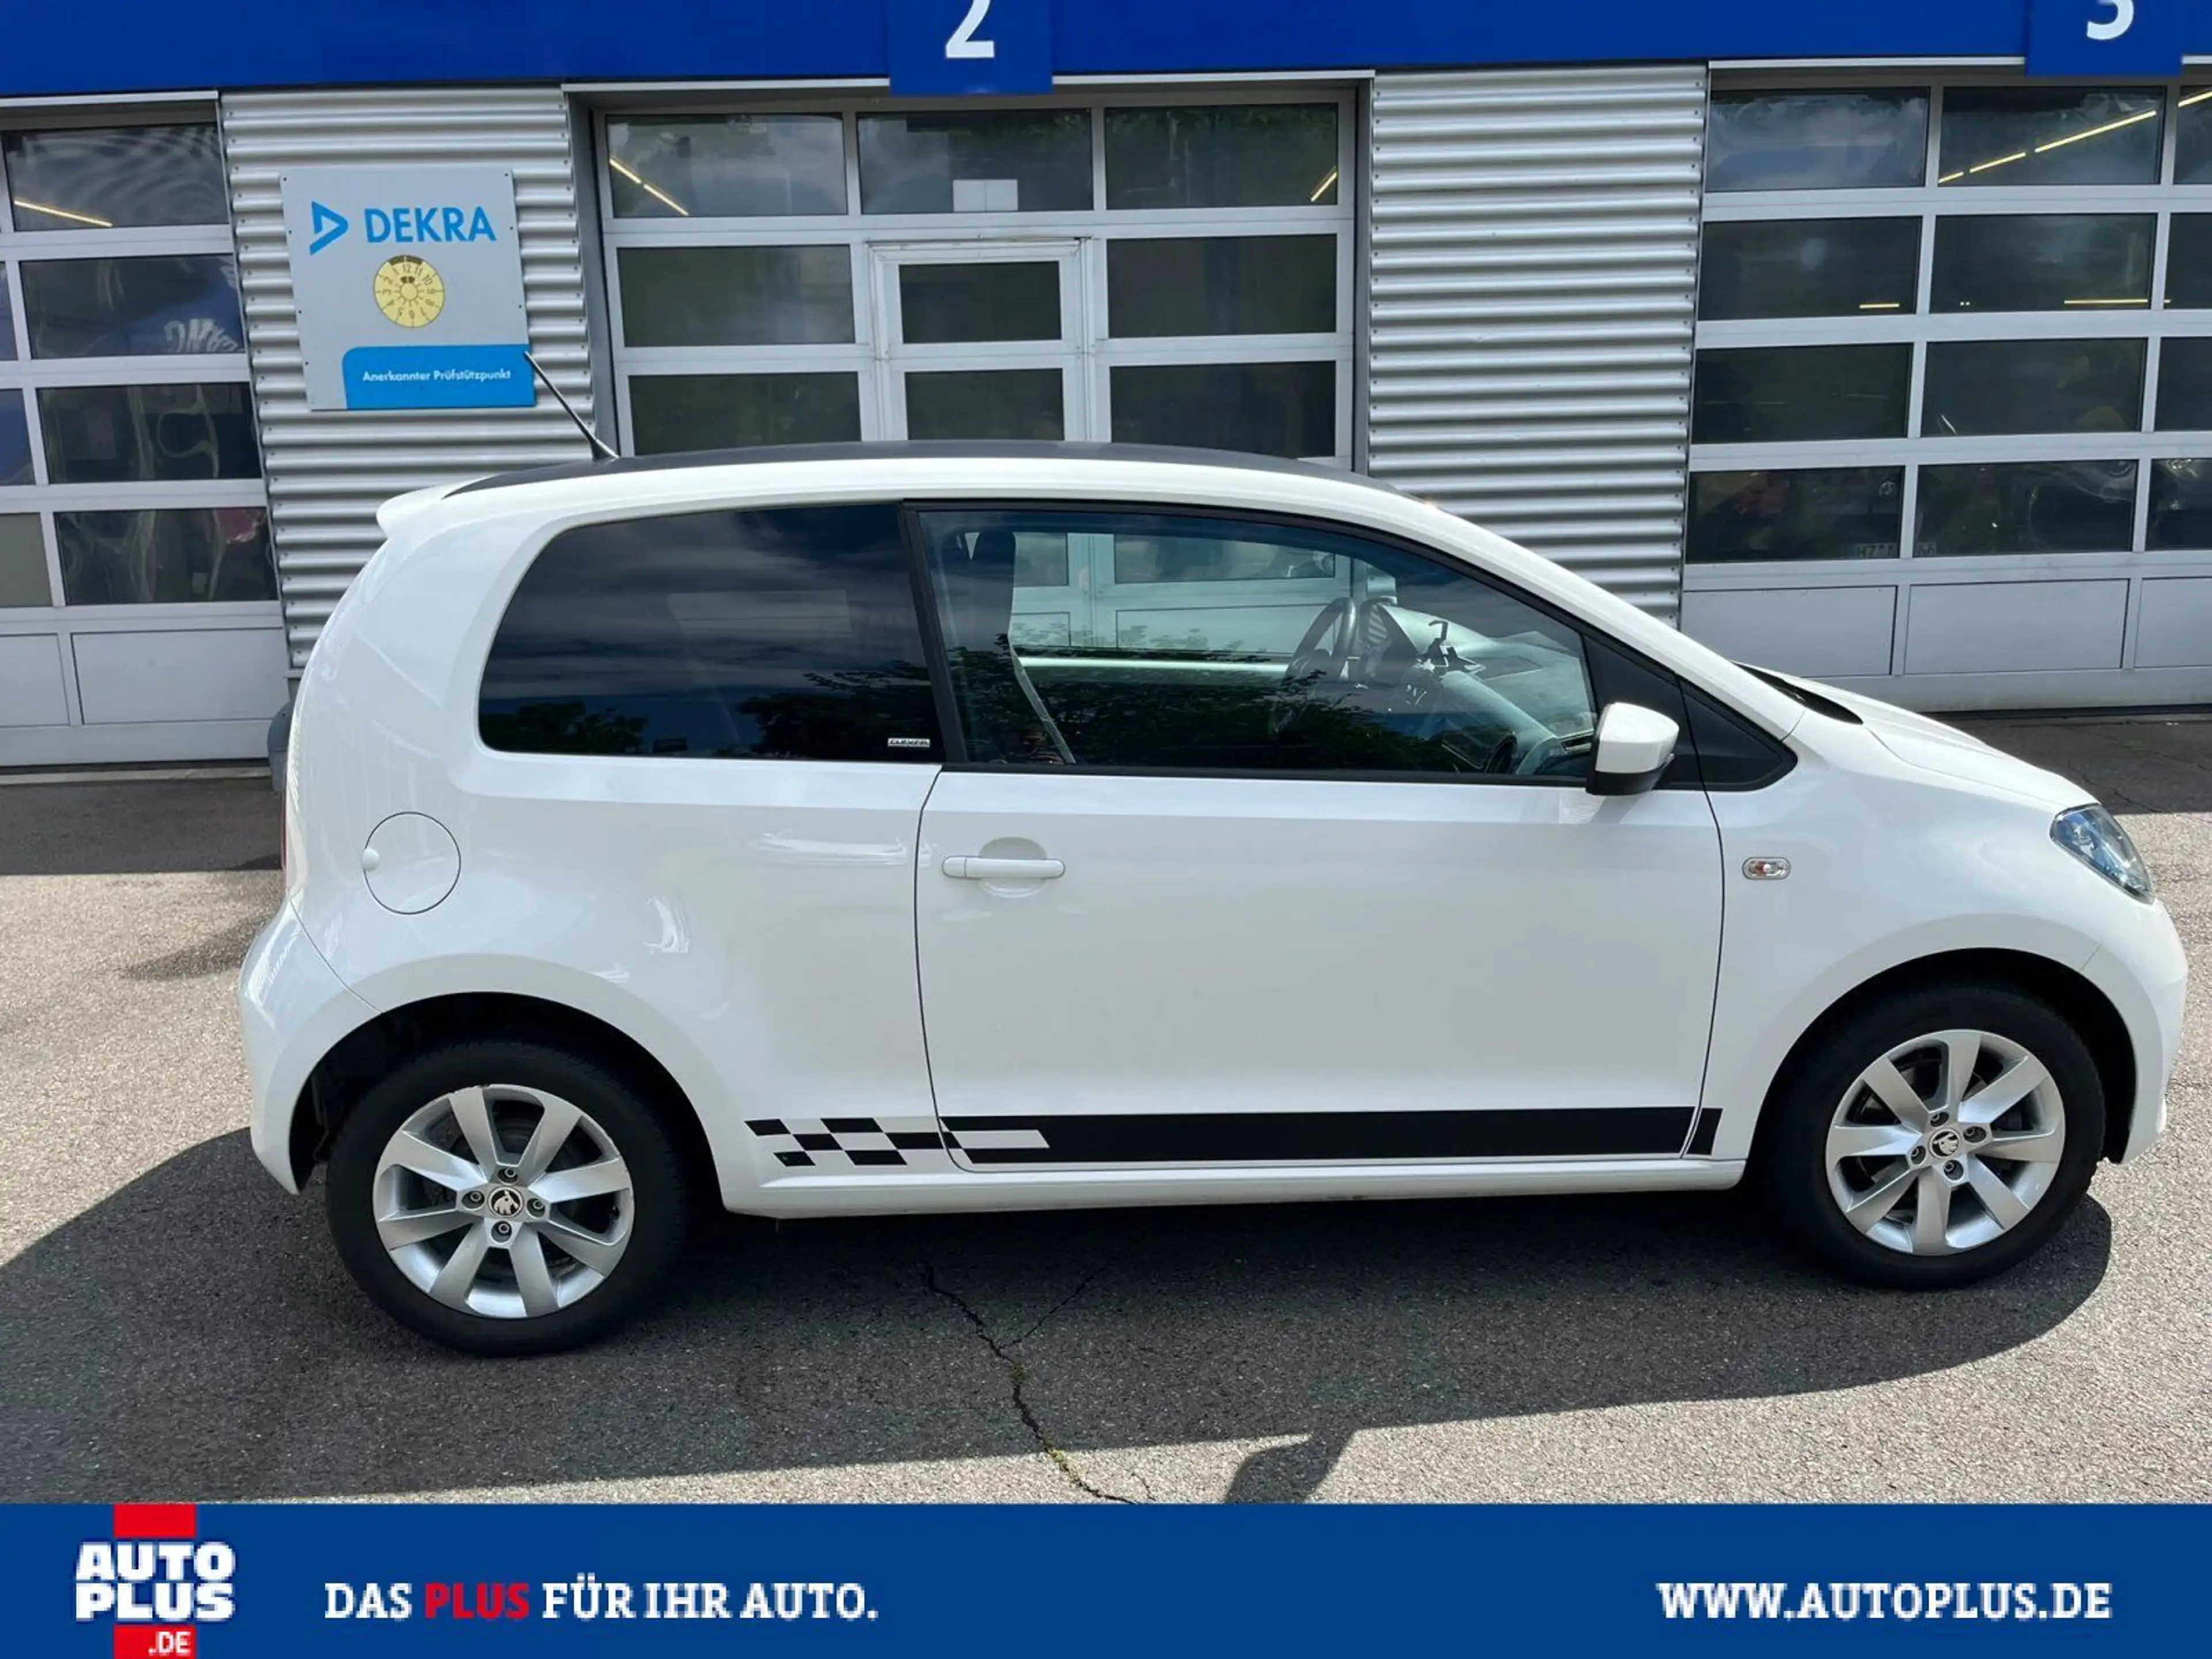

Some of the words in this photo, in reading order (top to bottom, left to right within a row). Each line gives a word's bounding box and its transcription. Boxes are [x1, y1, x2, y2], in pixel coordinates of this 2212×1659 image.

[364, 206, 497, 243] DEKRA
[362, 371, 430, 381] Anerkannter
[433, 369, 511, 382] Prüfstützpunkt
